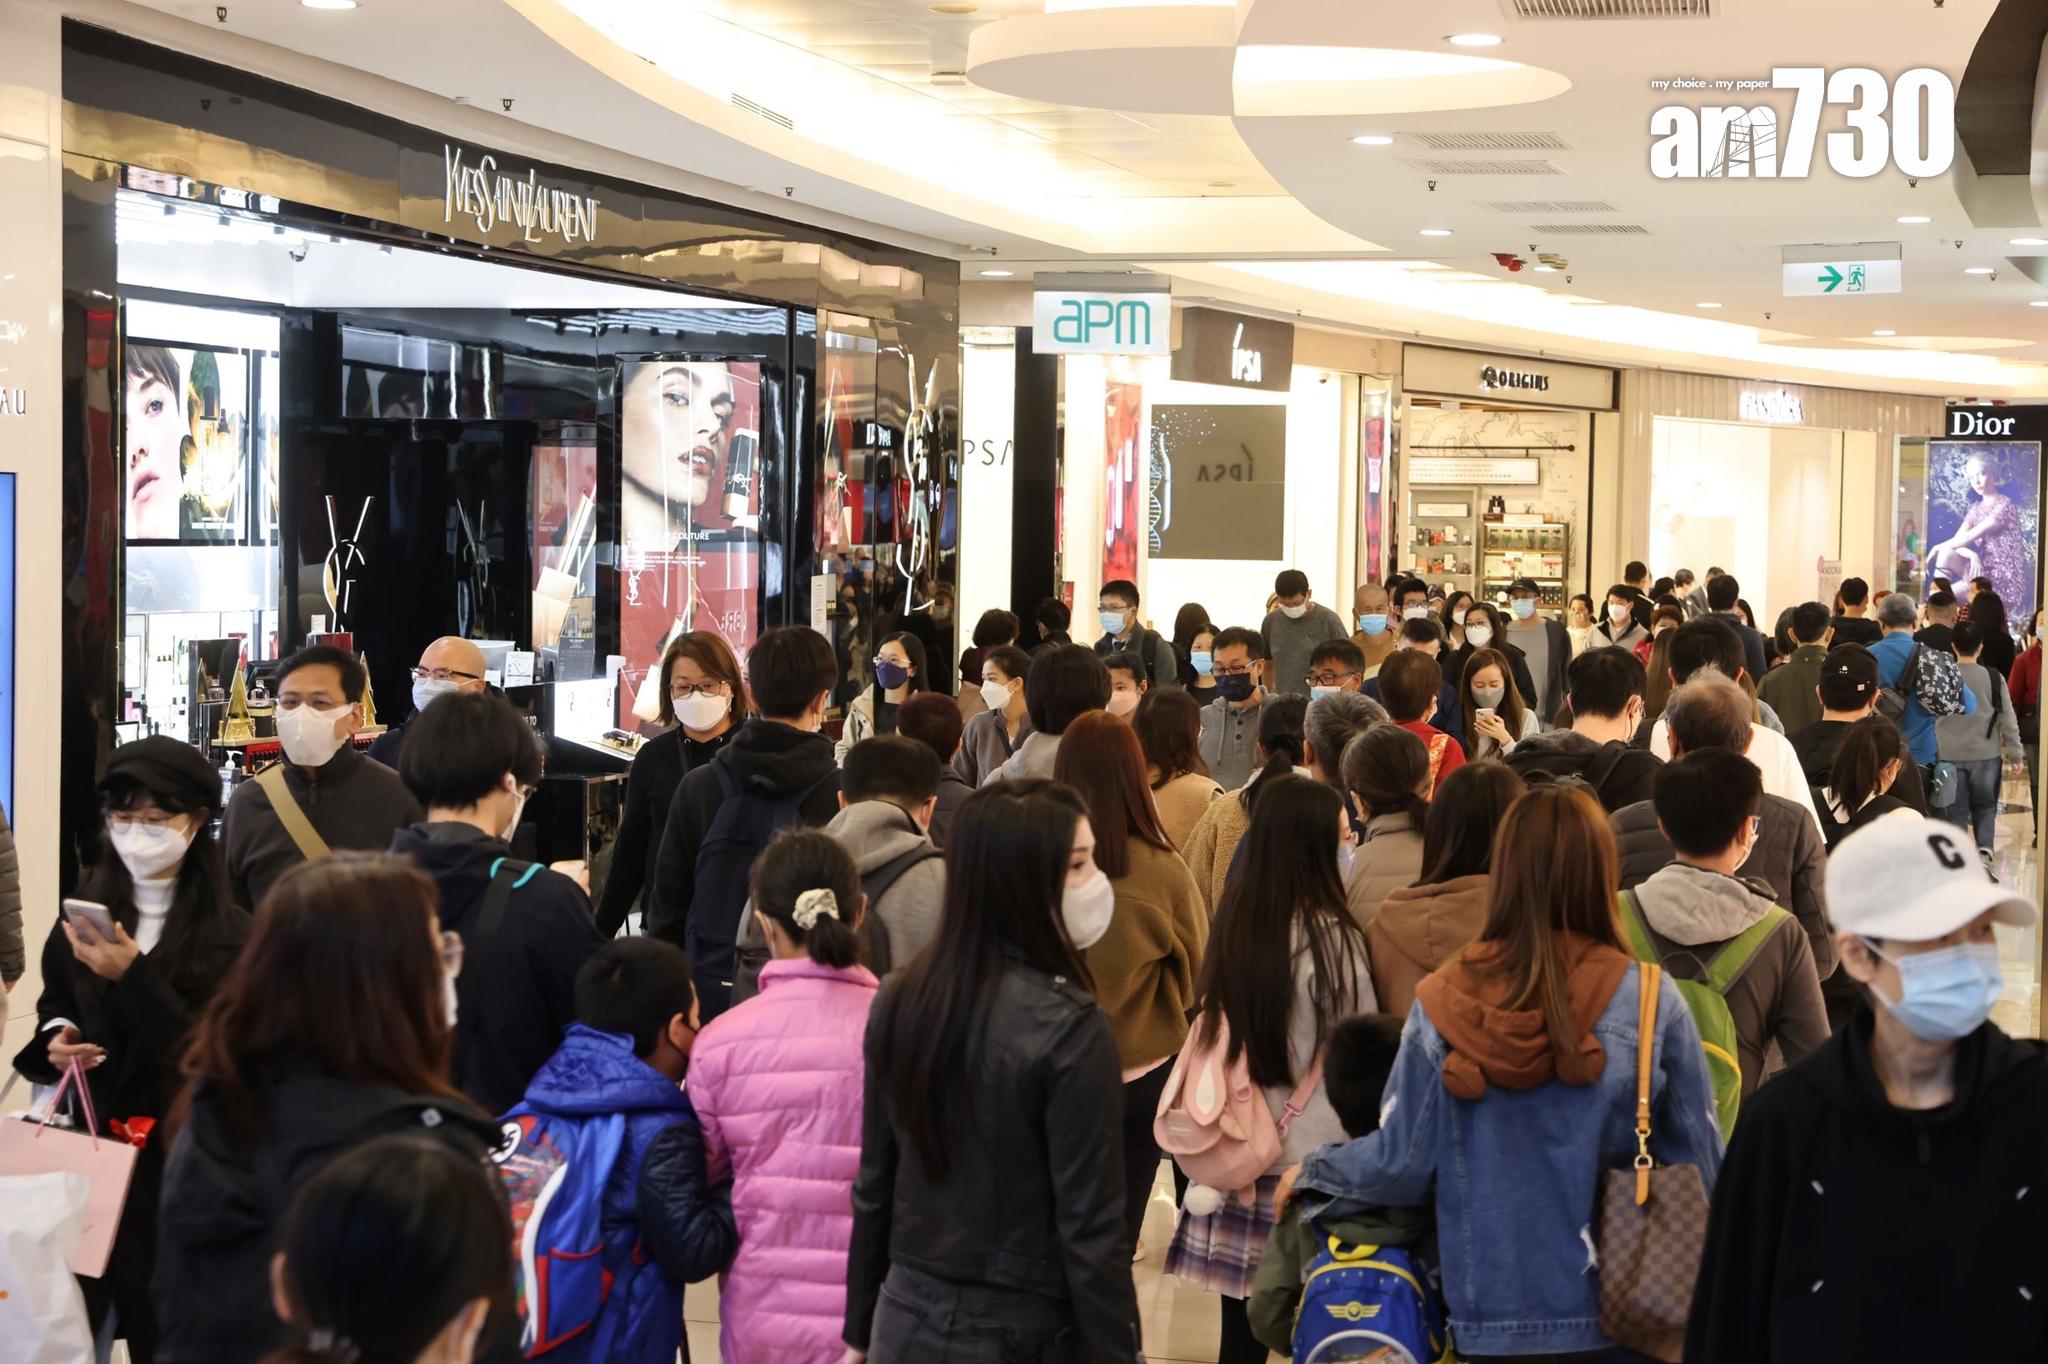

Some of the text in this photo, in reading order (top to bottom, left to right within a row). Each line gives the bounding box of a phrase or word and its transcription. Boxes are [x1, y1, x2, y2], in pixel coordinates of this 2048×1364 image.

[1498, 370, 1549, 391] ORIGINS
[1949, 411, 2016, 436] Dior
[1927, 834, 1966, 870] C
